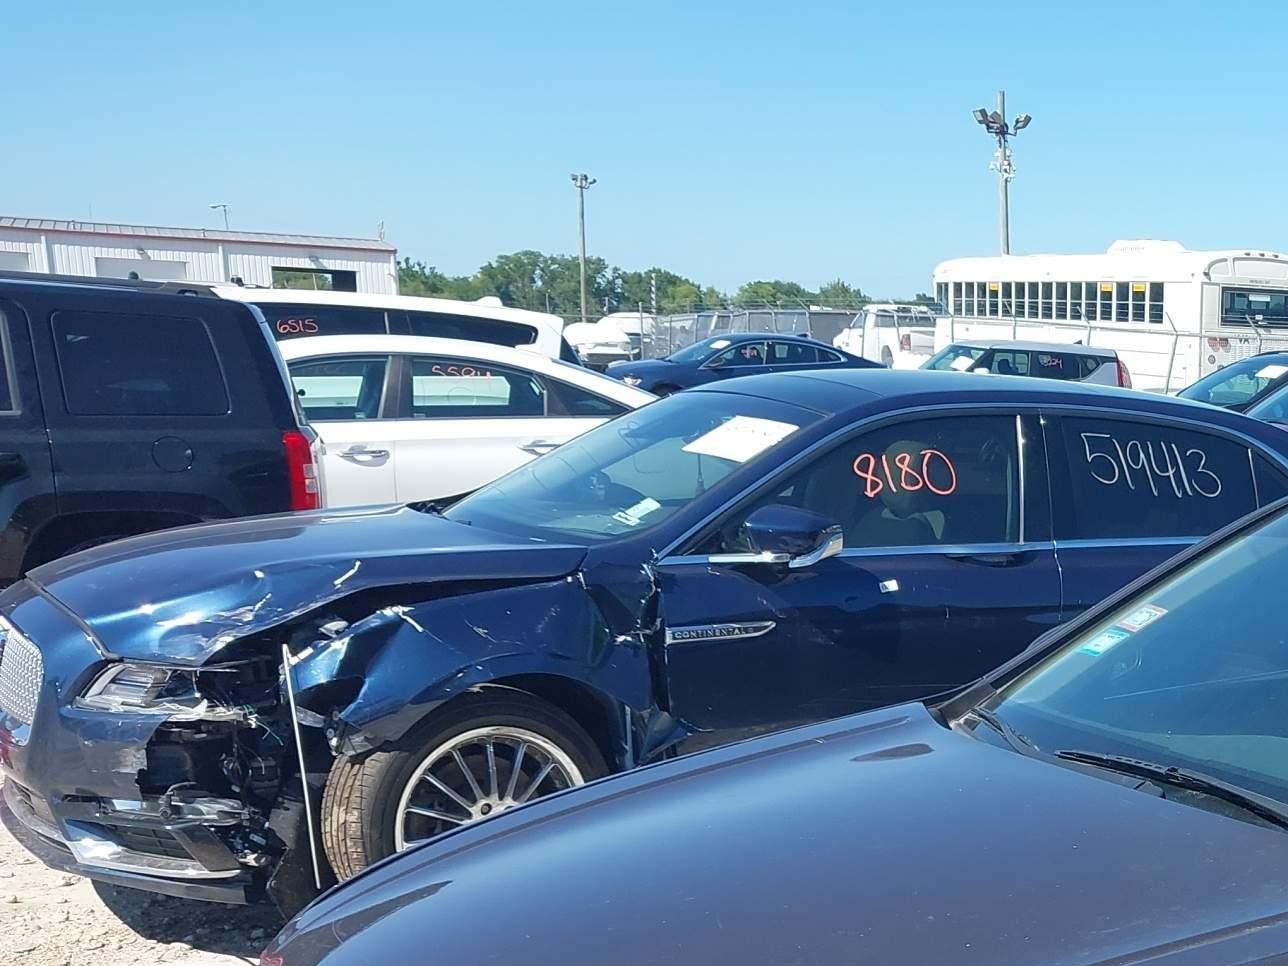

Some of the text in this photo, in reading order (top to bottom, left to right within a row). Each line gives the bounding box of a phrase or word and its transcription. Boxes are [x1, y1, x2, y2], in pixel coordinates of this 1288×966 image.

[276, 318, 319, 333] 6515
[853, 449, 957, 498] 8180
[1080, 432, 1222, 498] 519413
[674, 627, 747, 639] CONTINENTAL
